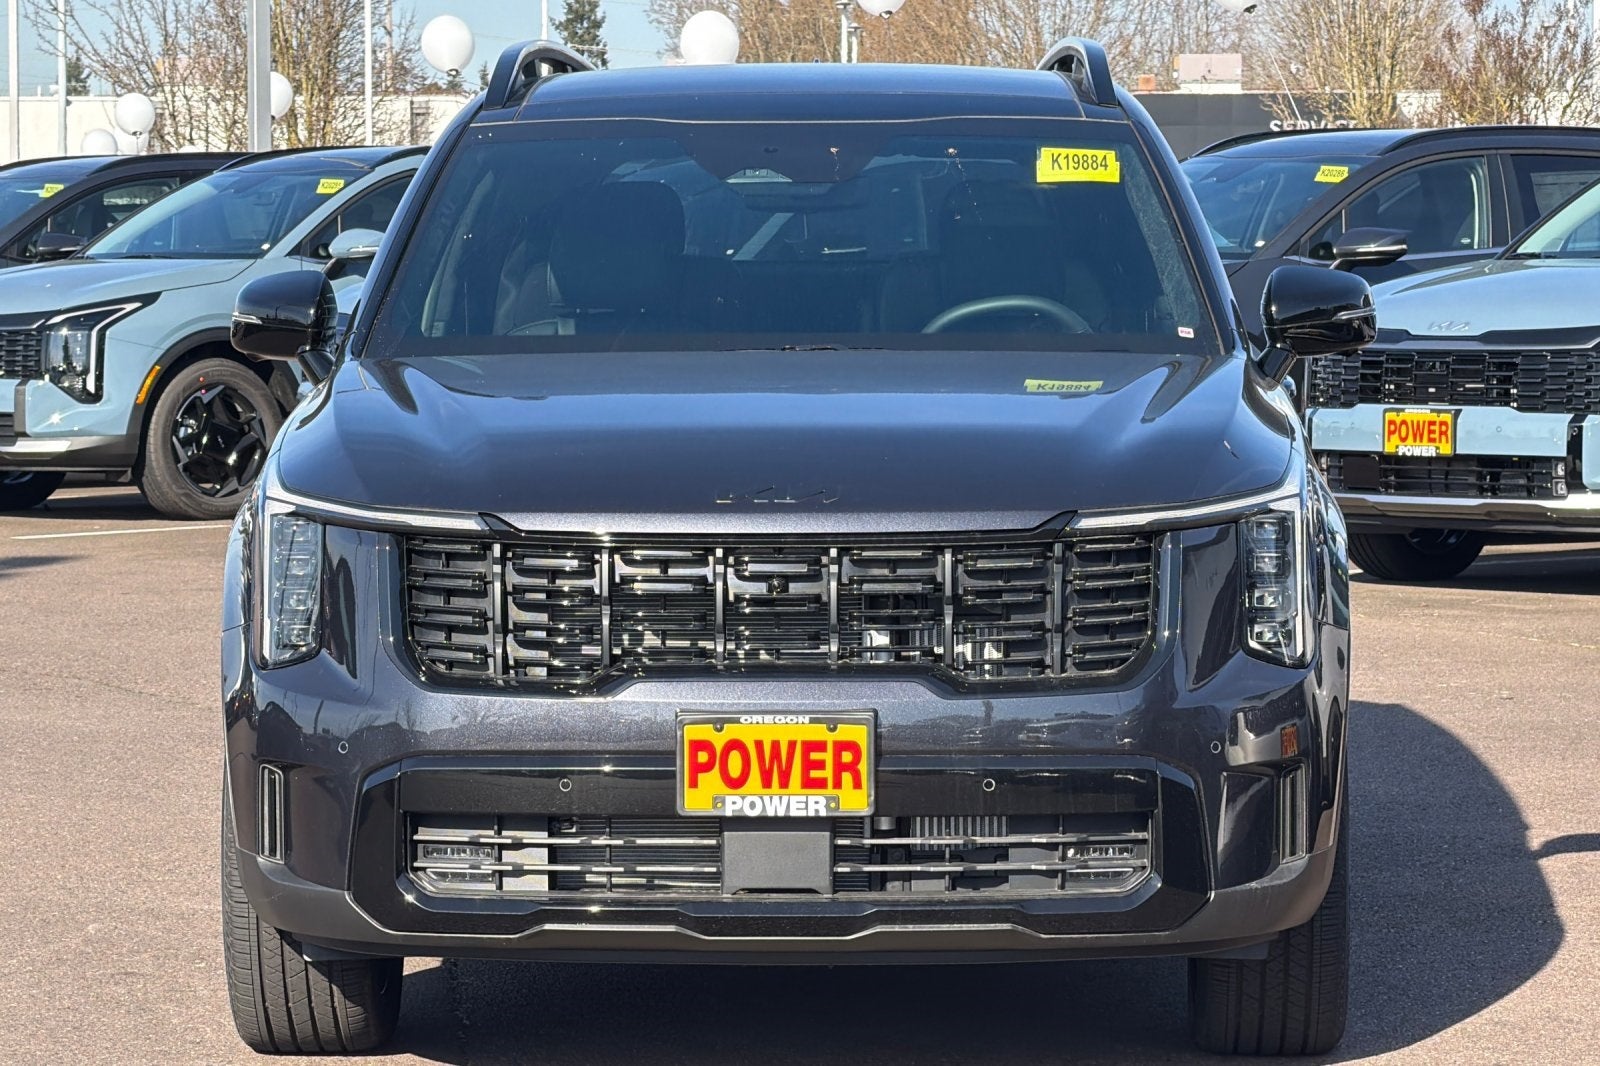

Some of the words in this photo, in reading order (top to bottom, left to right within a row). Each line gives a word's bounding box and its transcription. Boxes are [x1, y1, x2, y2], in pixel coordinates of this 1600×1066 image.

[1051, 153, 1109, 171] K19884
[1387, 419, 1450, 443] POWER
[1398, 446, 1436, 457] POWER
[739, 715, 810, 724] OREGON
[688, 738, 863, 790] POWER
[724, 795, 827, 817] POWER
